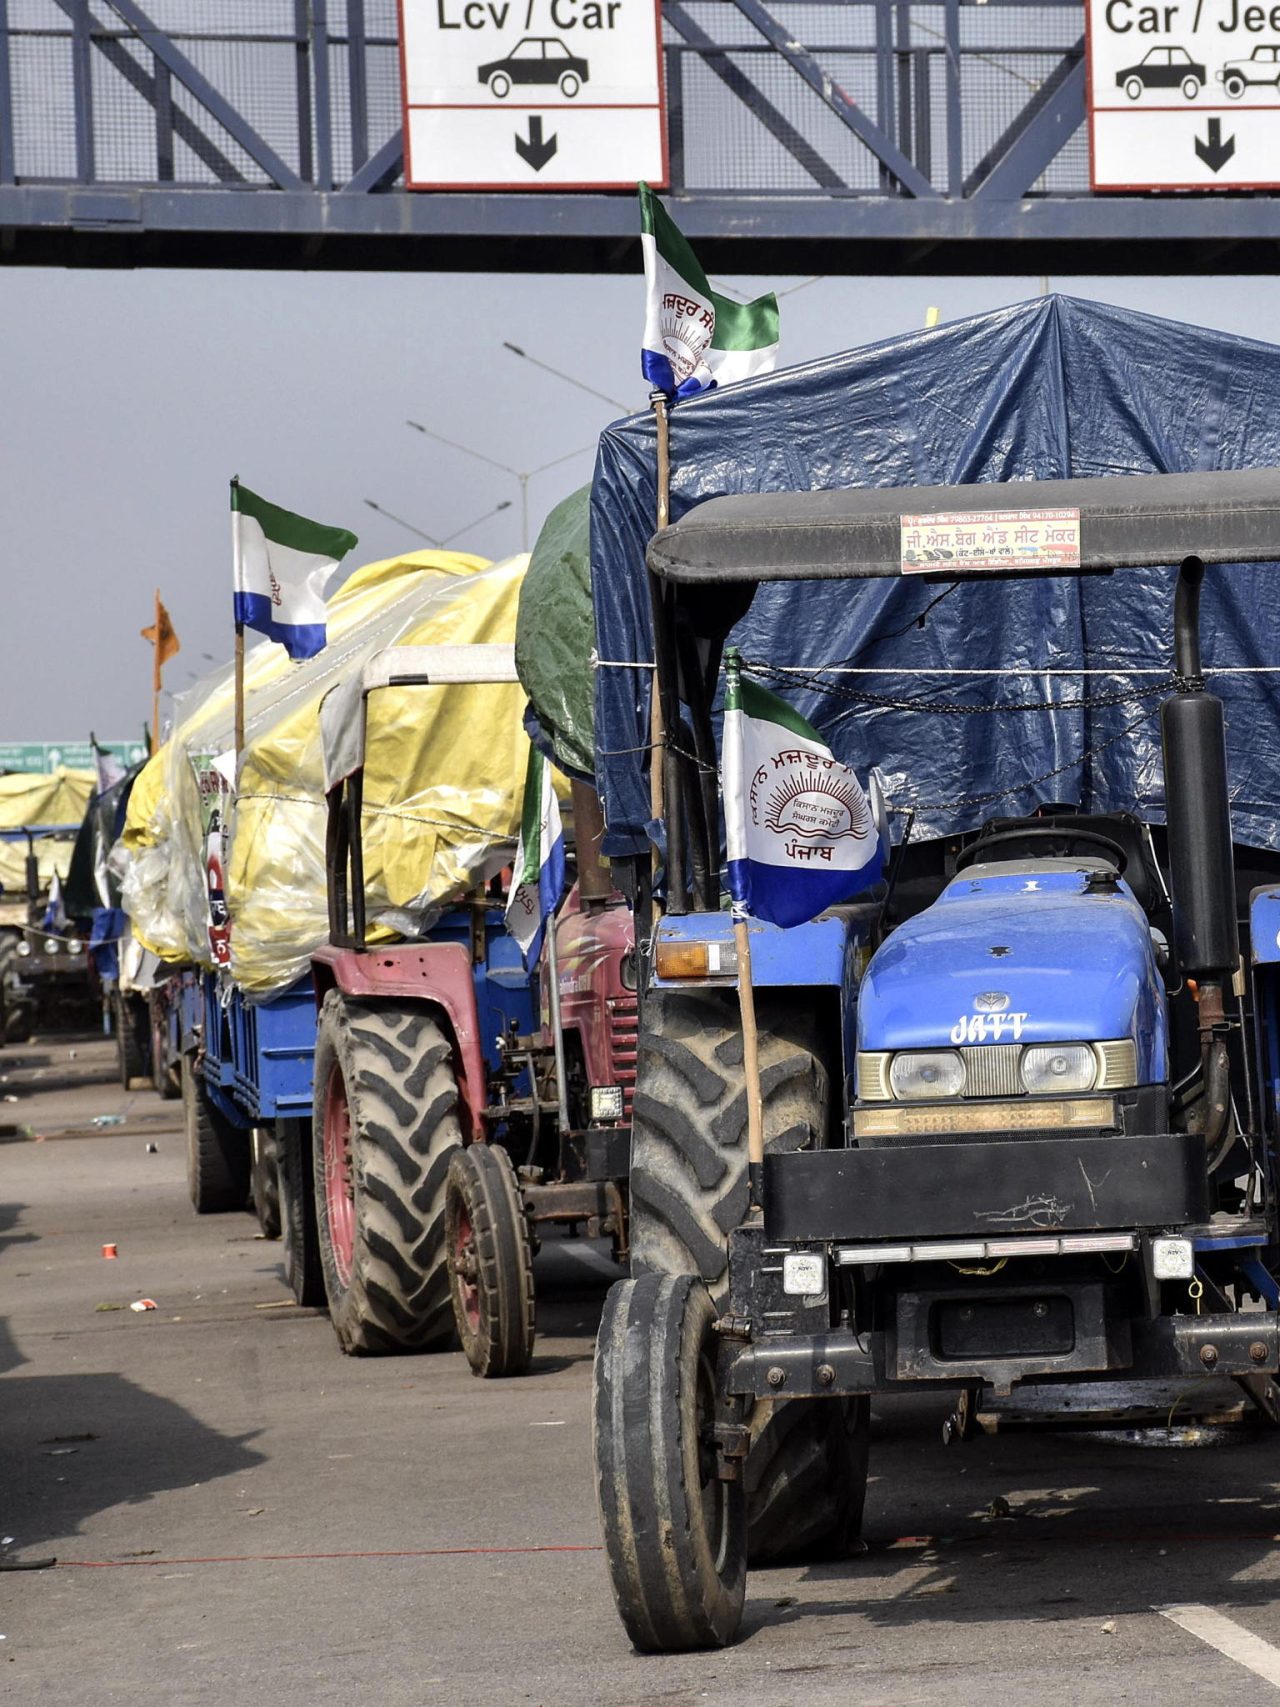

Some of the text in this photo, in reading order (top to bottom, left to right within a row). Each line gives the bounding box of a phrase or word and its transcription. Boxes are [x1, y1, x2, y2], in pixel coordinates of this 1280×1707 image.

[437, 0, 510, 29] Lcv
[550, 0, 622, 29] Car
[1105, 0, 1179, 33] Car
[785, 838, 835, 861] ਪੰਜਾਬ
[951, 1012, 1028, 1044] JATT
